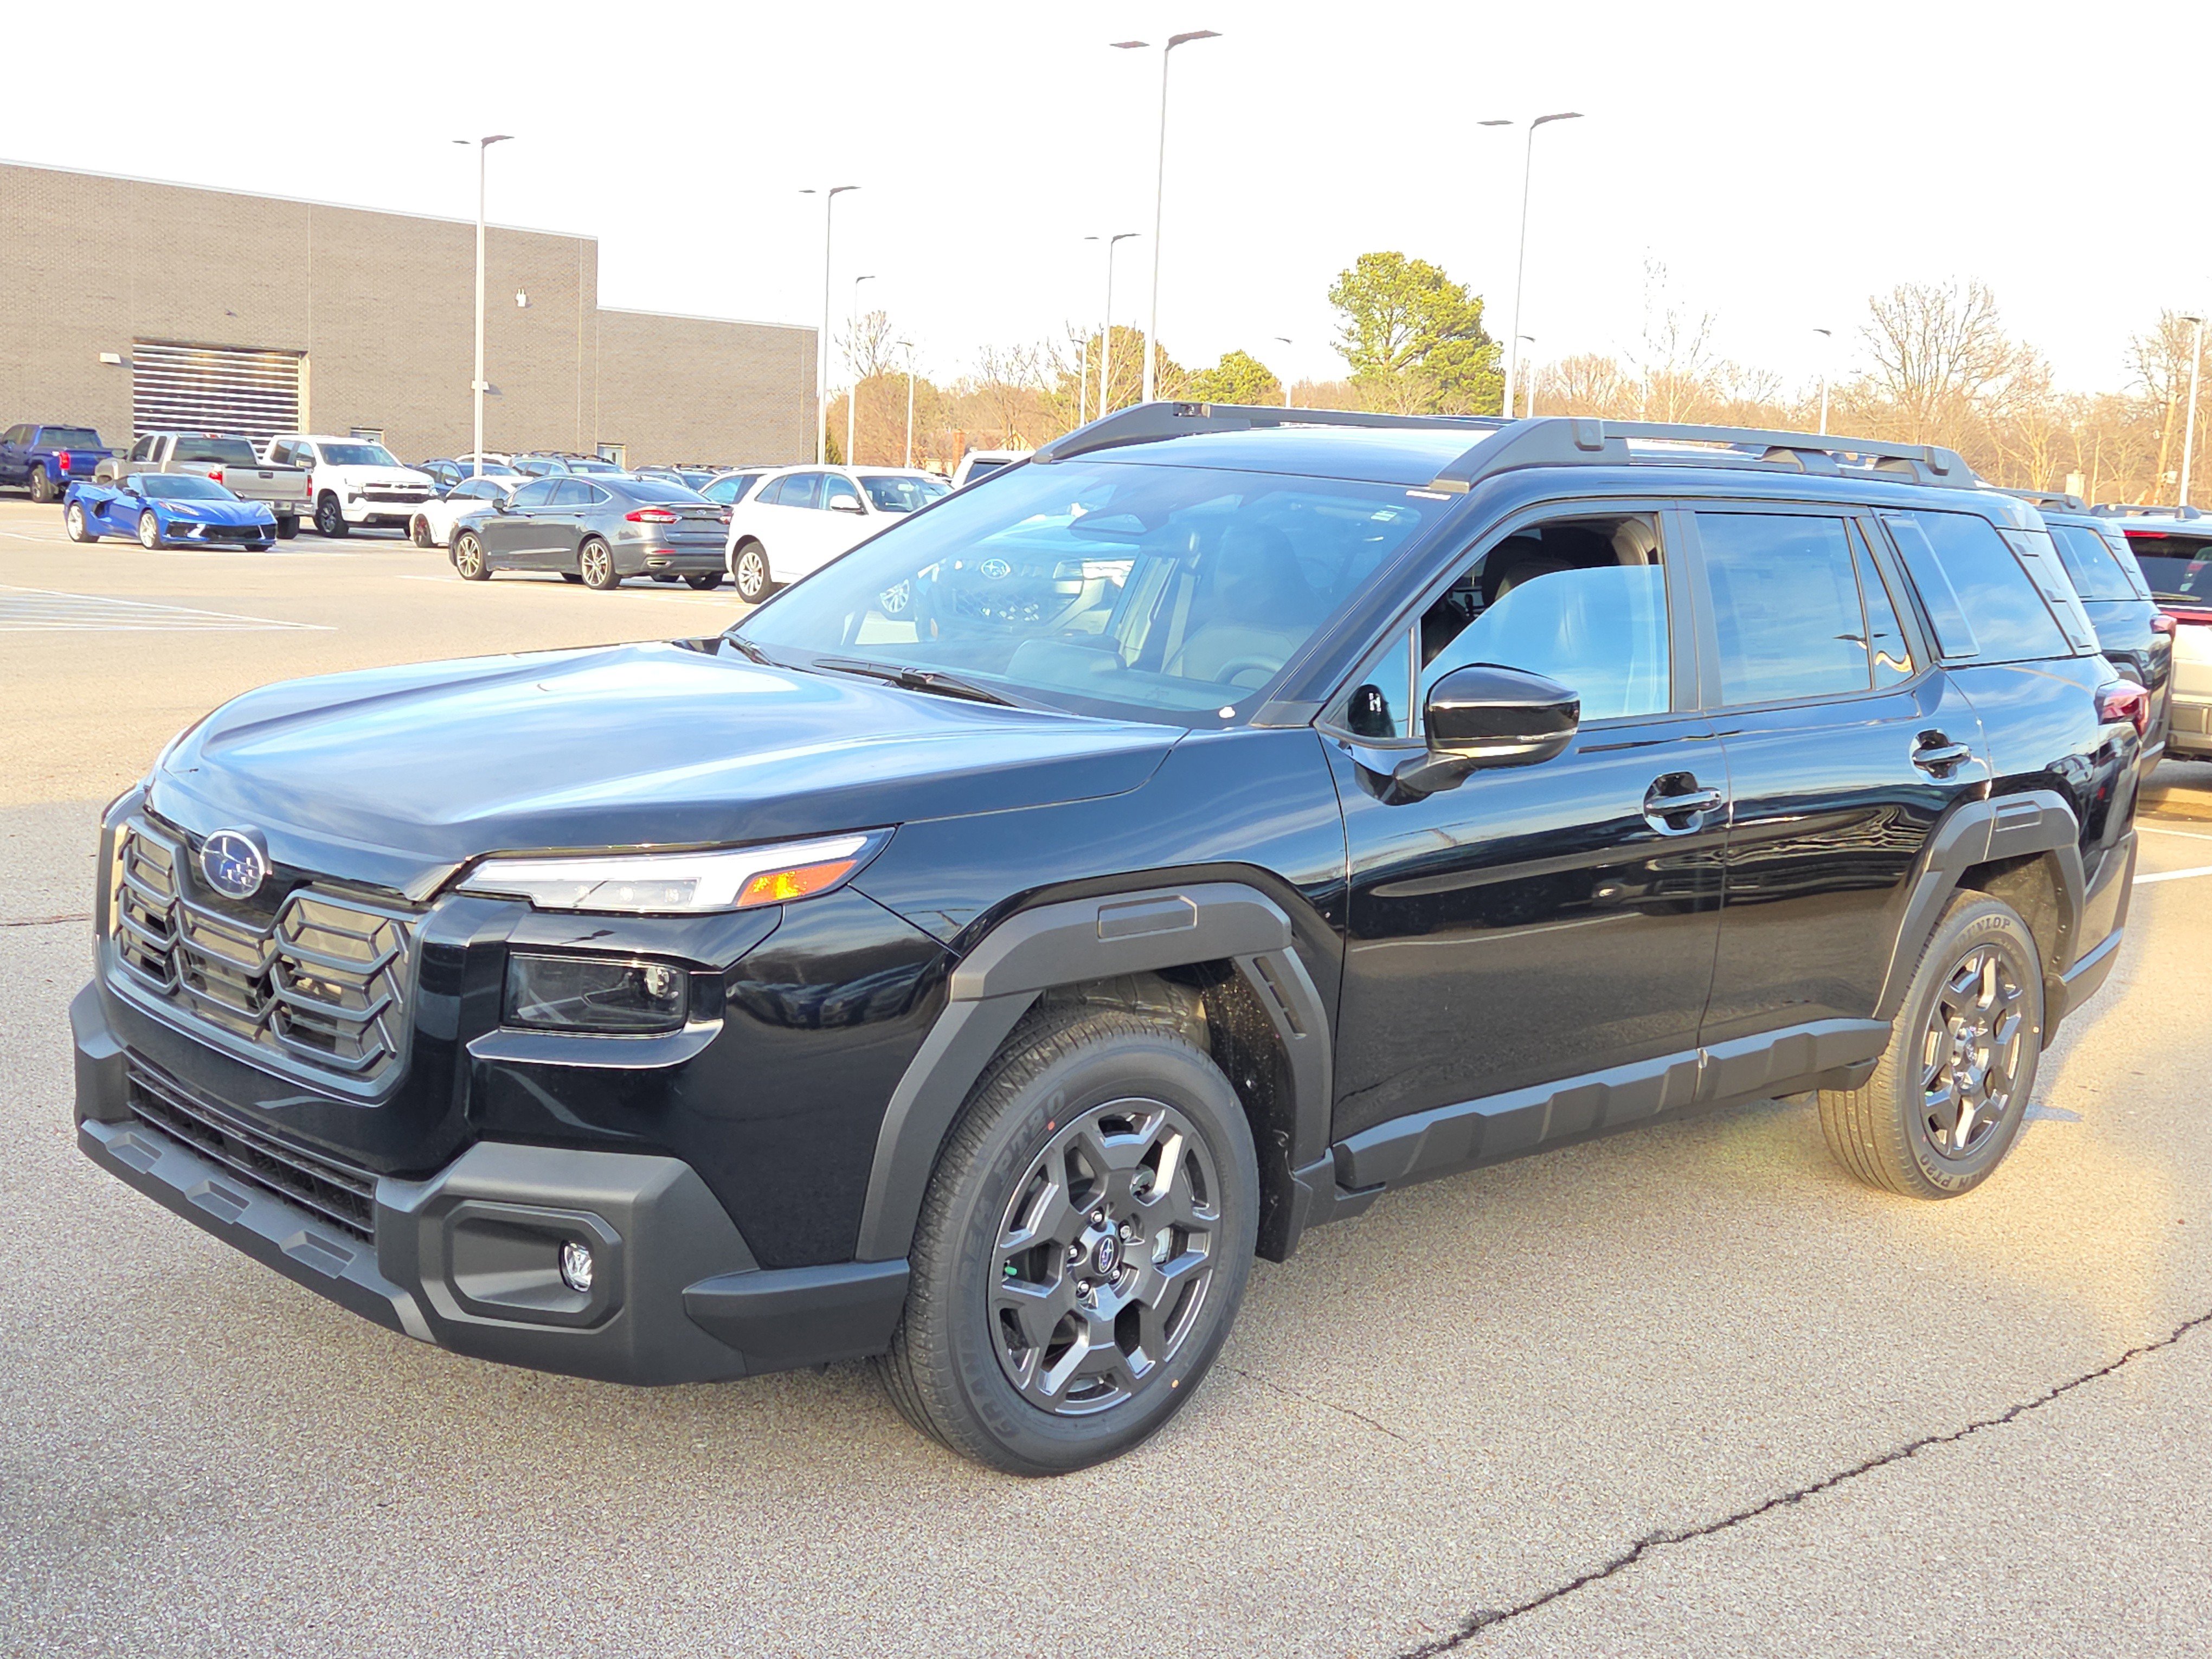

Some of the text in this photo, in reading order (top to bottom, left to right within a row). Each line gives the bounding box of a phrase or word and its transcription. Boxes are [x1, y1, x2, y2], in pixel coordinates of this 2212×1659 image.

[1956, 917, 2010, 948] DUNLOP
[993, 1089, 1065, 1185] PT20
[1920, 1154, 1954, 1187] PT20
